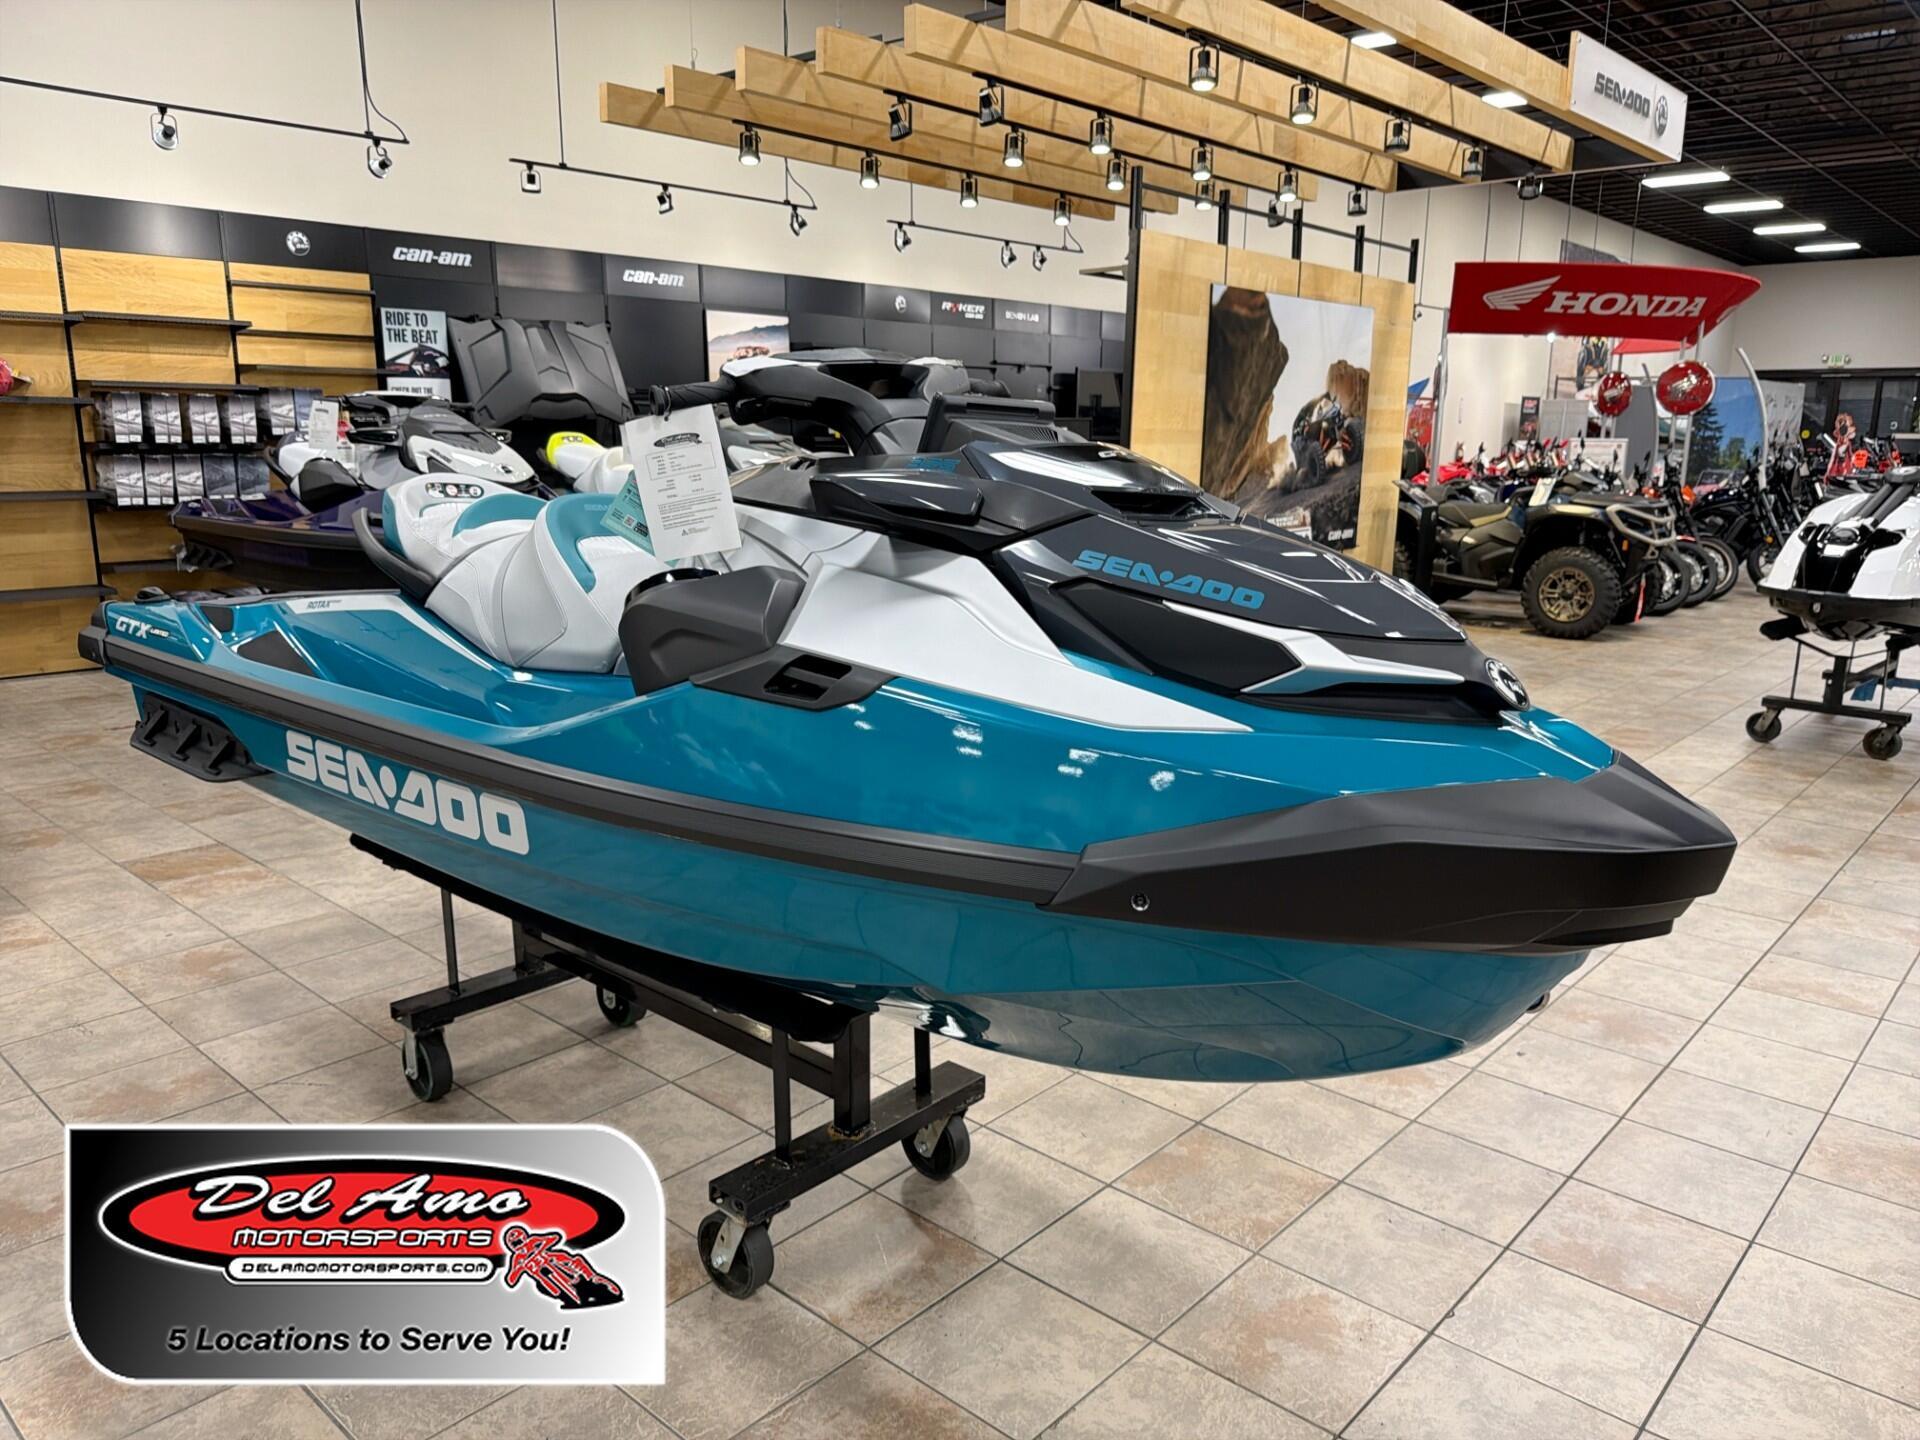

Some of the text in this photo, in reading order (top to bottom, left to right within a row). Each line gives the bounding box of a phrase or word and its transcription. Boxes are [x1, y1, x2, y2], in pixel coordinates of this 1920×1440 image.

[392, 246, 472, 267] can-am
[622, 269, 685, 288] can-am
[1544, 291, 1707, 318] HONDA
[384, 310, 428, 327] RIDE TO
[387, 328, 439, 345] THE BEAT
[115, 616, 152, 640] GTX
